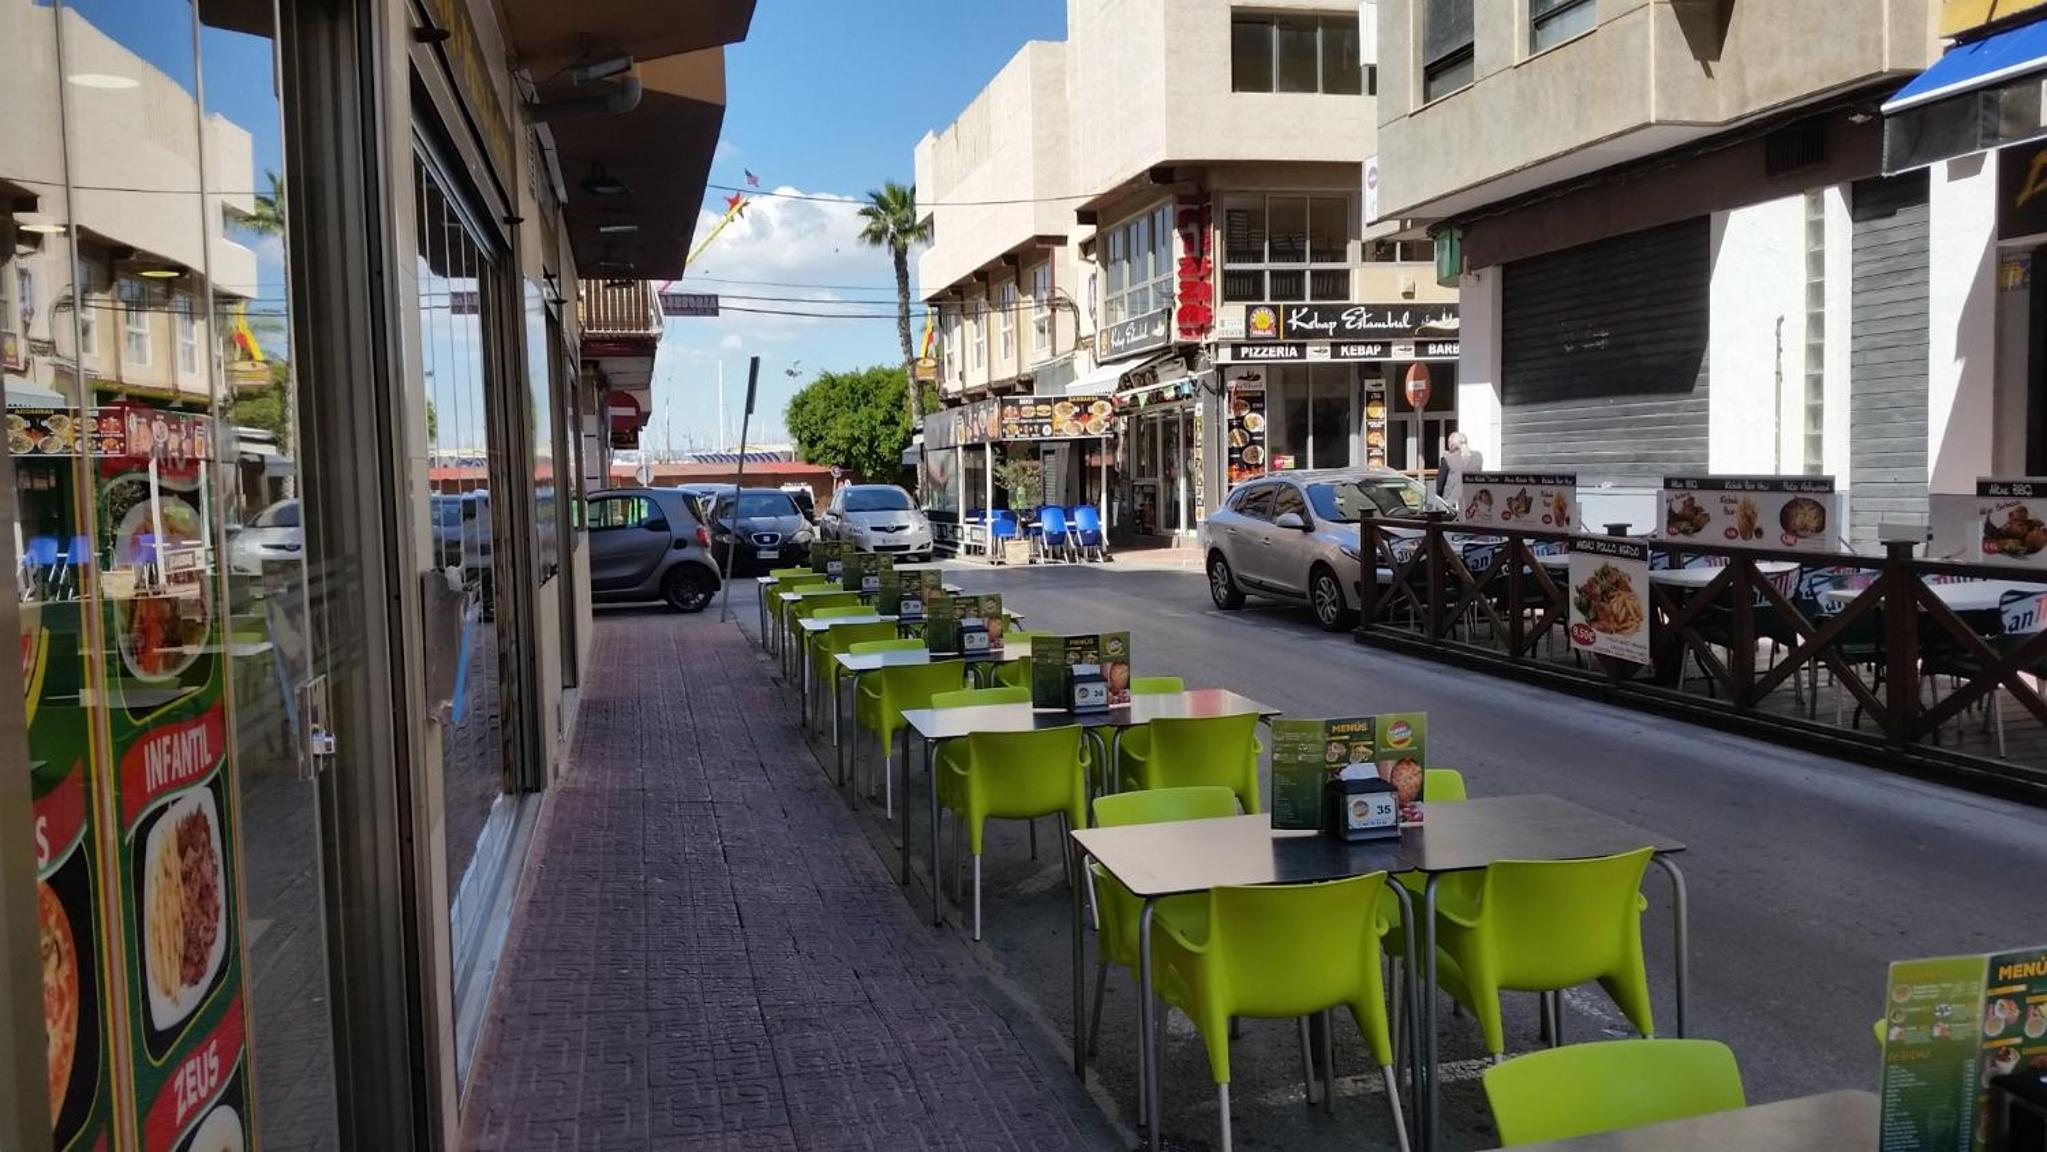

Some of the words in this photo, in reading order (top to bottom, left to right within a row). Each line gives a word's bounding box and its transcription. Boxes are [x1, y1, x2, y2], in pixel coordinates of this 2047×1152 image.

[1341, 306, 1413, 330] Estambul
[1241, 343, 1298, 358] PIZZERÍA
[1340, 345, 1382, 356] KEBAP
[2012, 484, 2033, 496] BBQ
[145, 724, 212, 794] INFANTIL
[1377, 805, 1391, 815] 35
[175, 1039, 220, 1127] ZEUS
